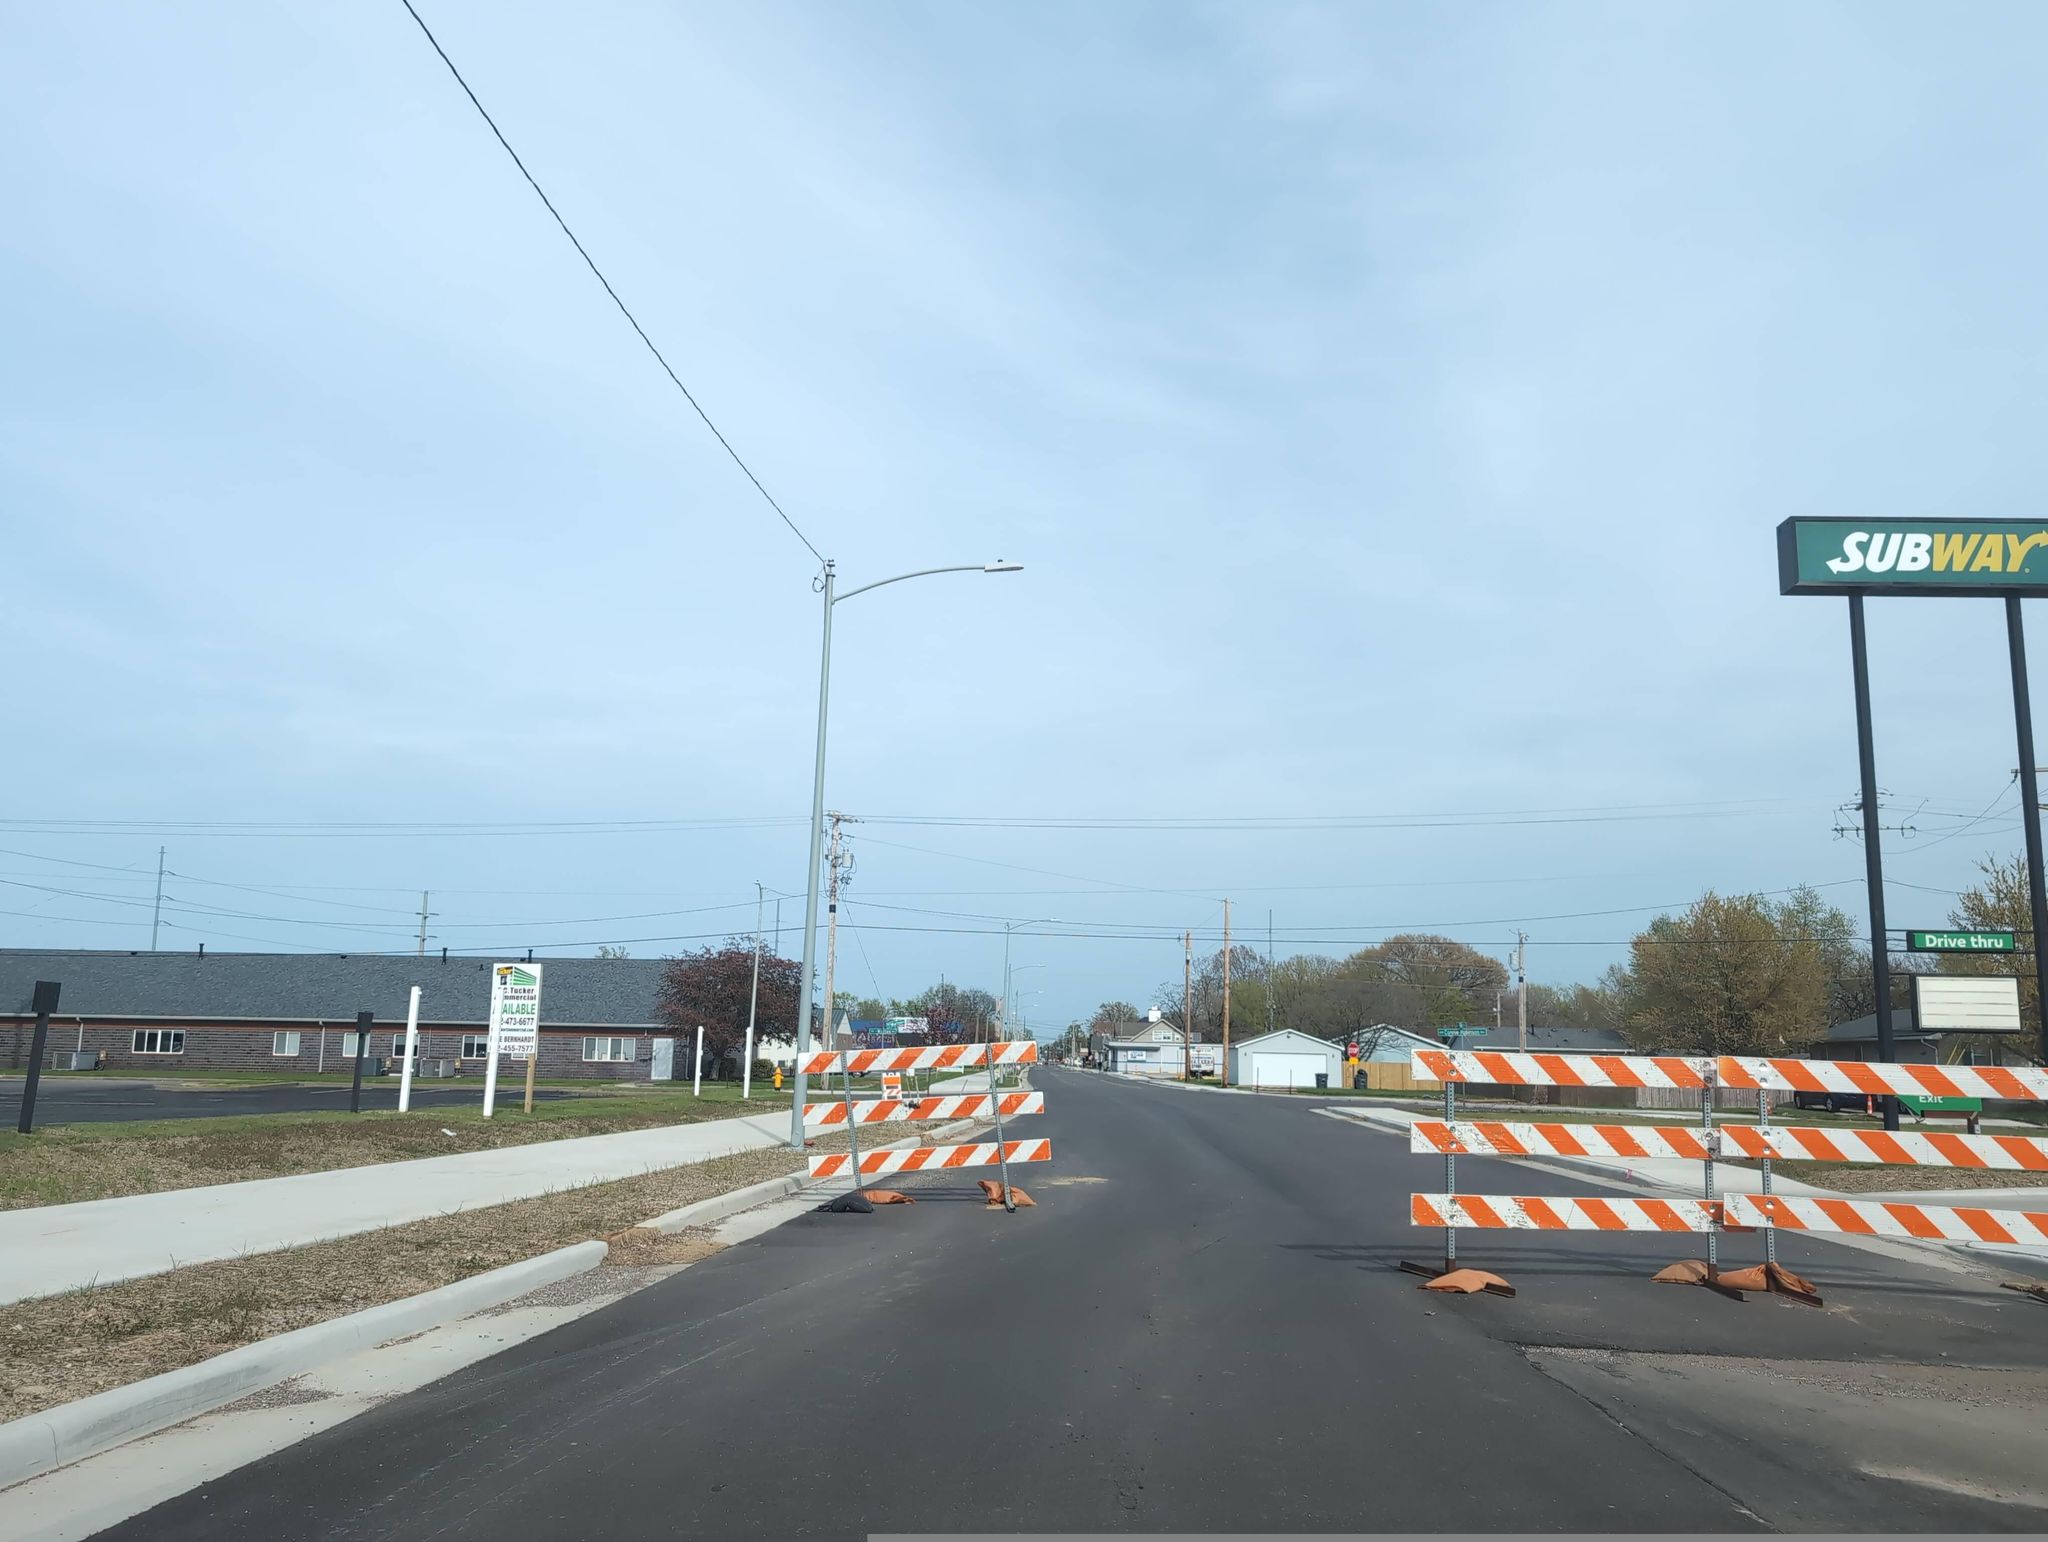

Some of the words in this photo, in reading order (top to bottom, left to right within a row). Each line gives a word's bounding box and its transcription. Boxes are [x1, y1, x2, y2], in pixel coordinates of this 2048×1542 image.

[1826, 531, 2048, 574] SUBWAY
[1925, 934, 1966, 948] Drive
[1970, 935, 2003, 948] thru
[492, 1003, 536, 1015] AILABLE
